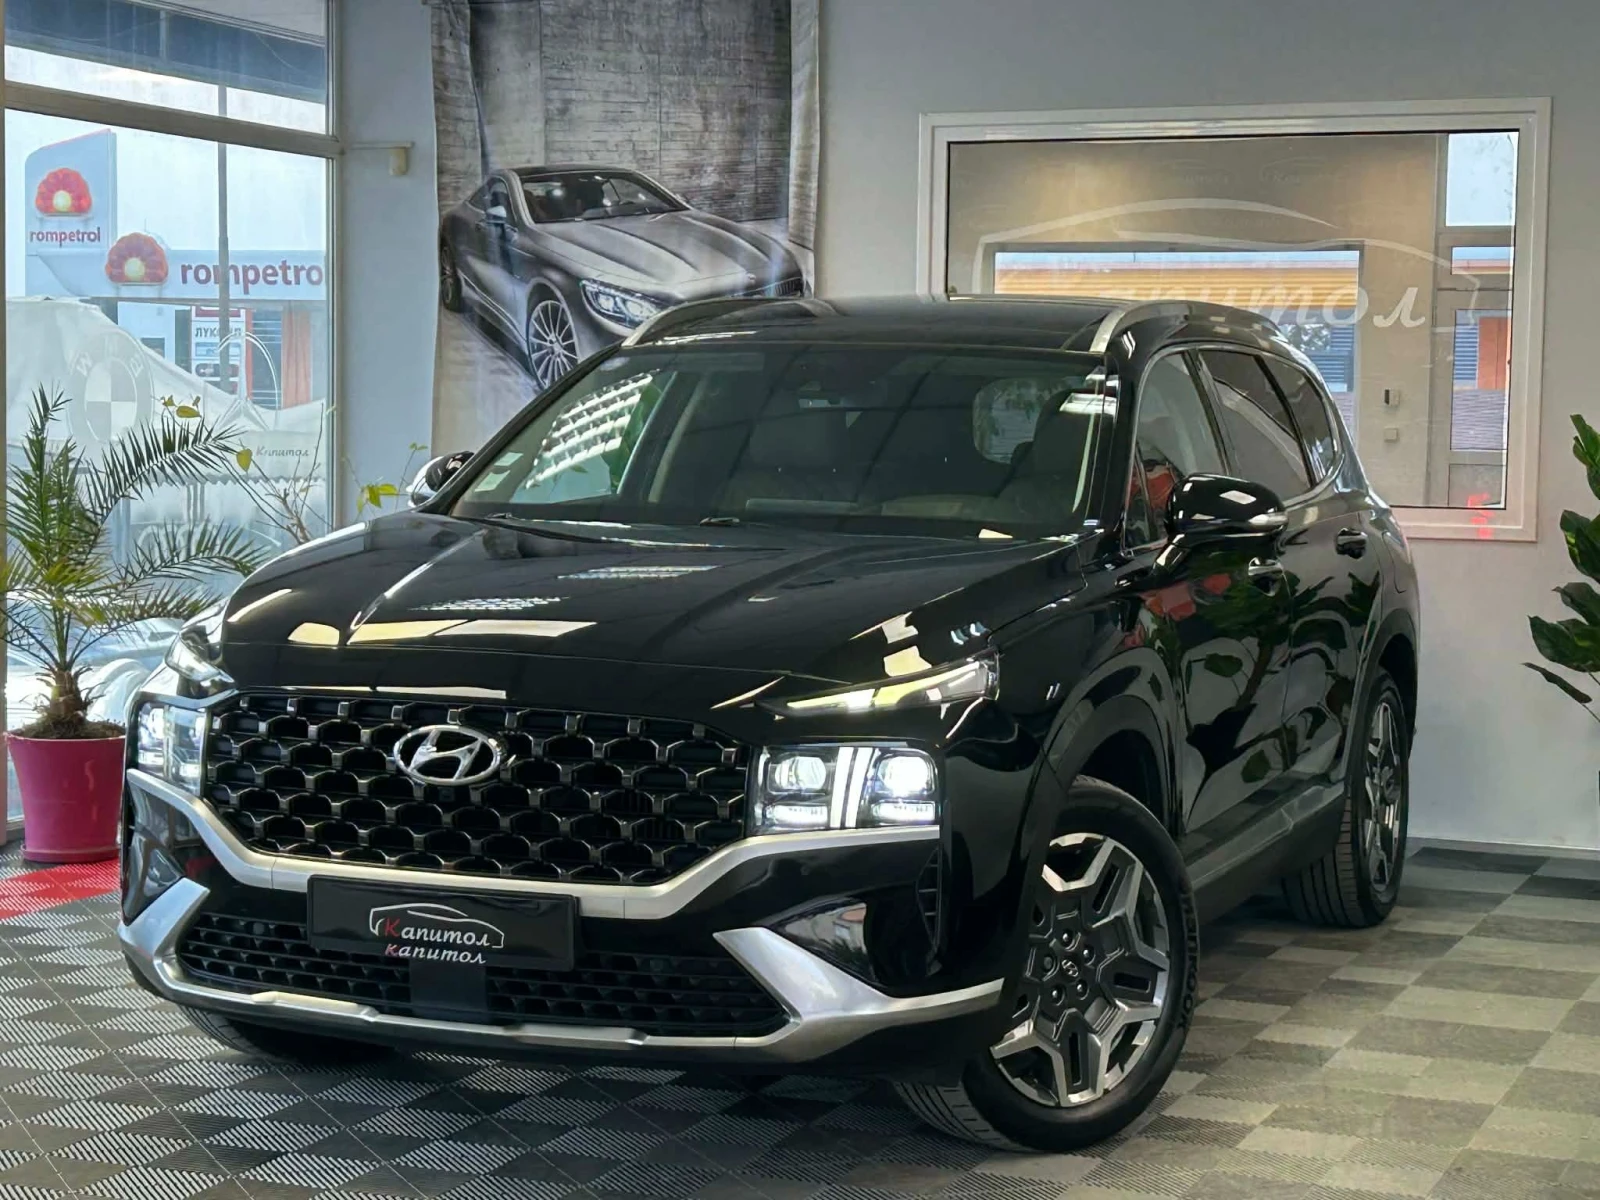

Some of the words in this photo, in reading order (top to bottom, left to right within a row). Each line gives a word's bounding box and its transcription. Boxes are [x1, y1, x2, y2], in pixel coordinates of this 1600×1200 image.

[29, 226, 101, 248] rompetrol
[195, 327, 242, 339] ЛУКЛ
[384, 917, 490, 946] Капитол
